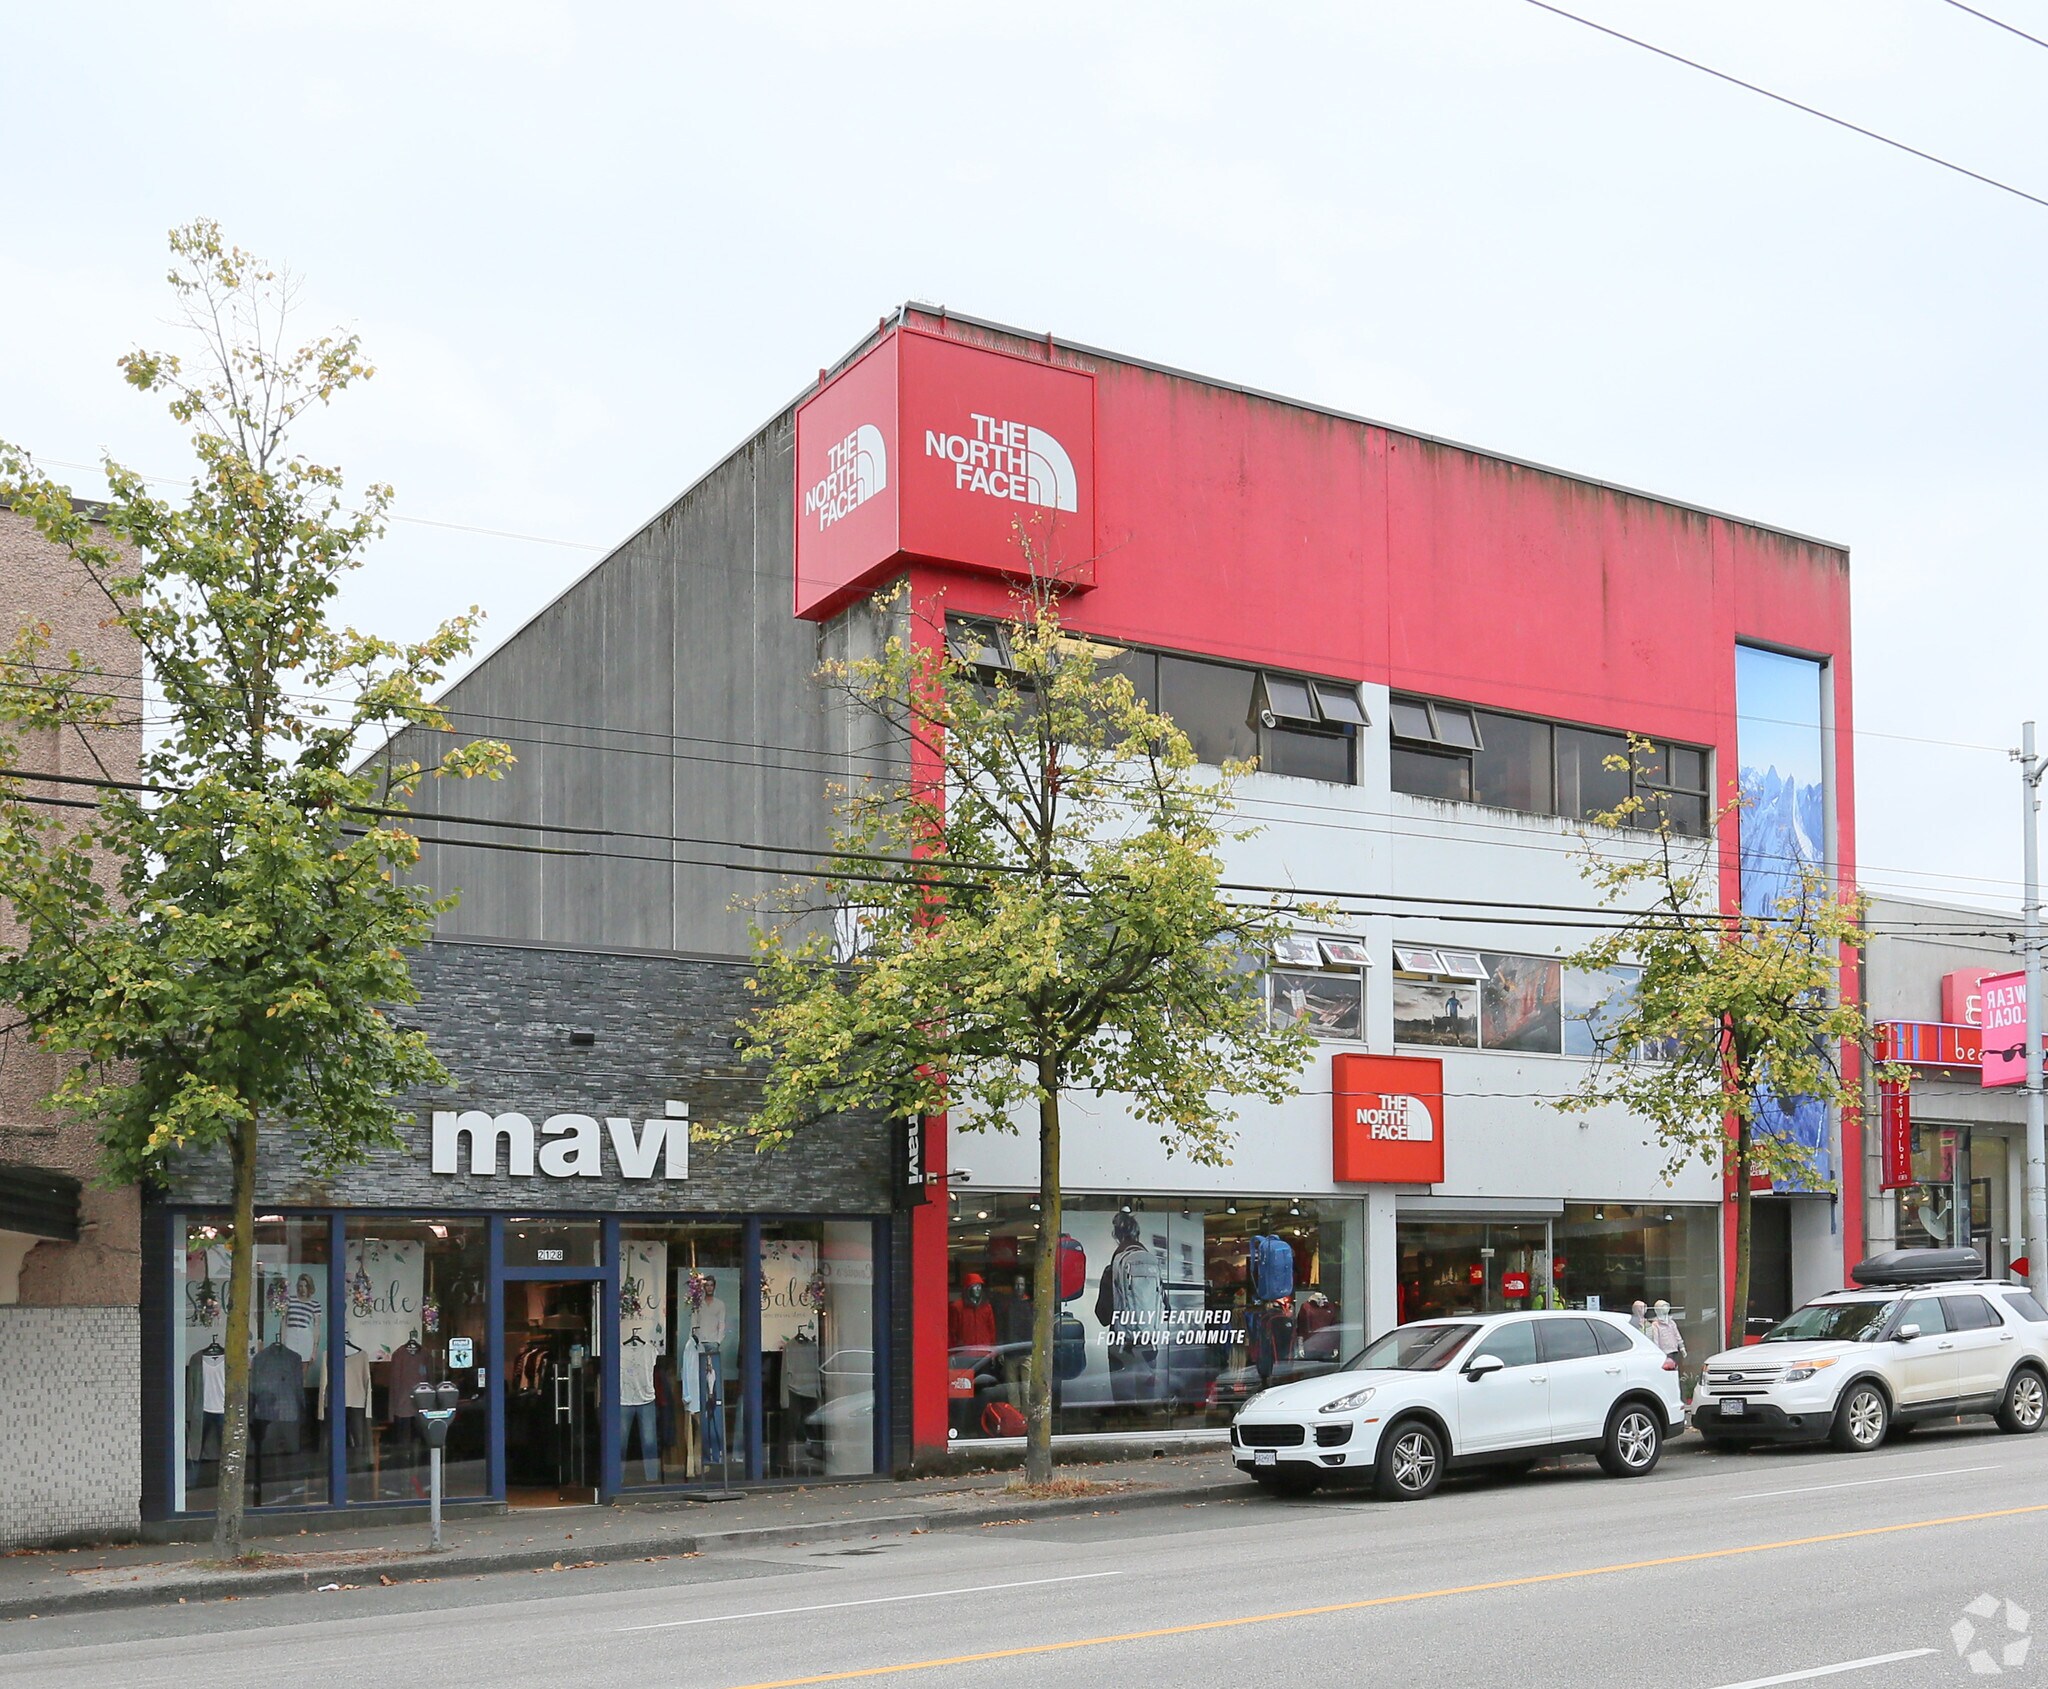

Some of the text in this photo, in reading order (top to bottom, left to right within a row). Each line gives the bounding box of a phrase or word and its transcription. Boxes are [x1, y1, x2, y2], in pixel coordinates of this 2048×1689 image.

[969, 412, 1026, 448] THE
[827, 430, 857, 471] THE
[926, 430, 1026, 476] NORTH
[805, 456, 857, 516] NORTH
[956, 463, 1027, 503] FACE
[819, 487, 857, 532] FACE
[1356, 1109, 1407, 1125] NORTH
[1378, 1095, 1407, 1110] THE
[432, 1100, 689, 1179] mavi
[1371, 1124, 1407, 1140] FACE
[538, 1250, 563, 1260] 2128
[1111, 1310, 1231, 1325] FULLY FEATURED
[1097, 1329, 1246, 1346] FOR YOUR COMMUTE
